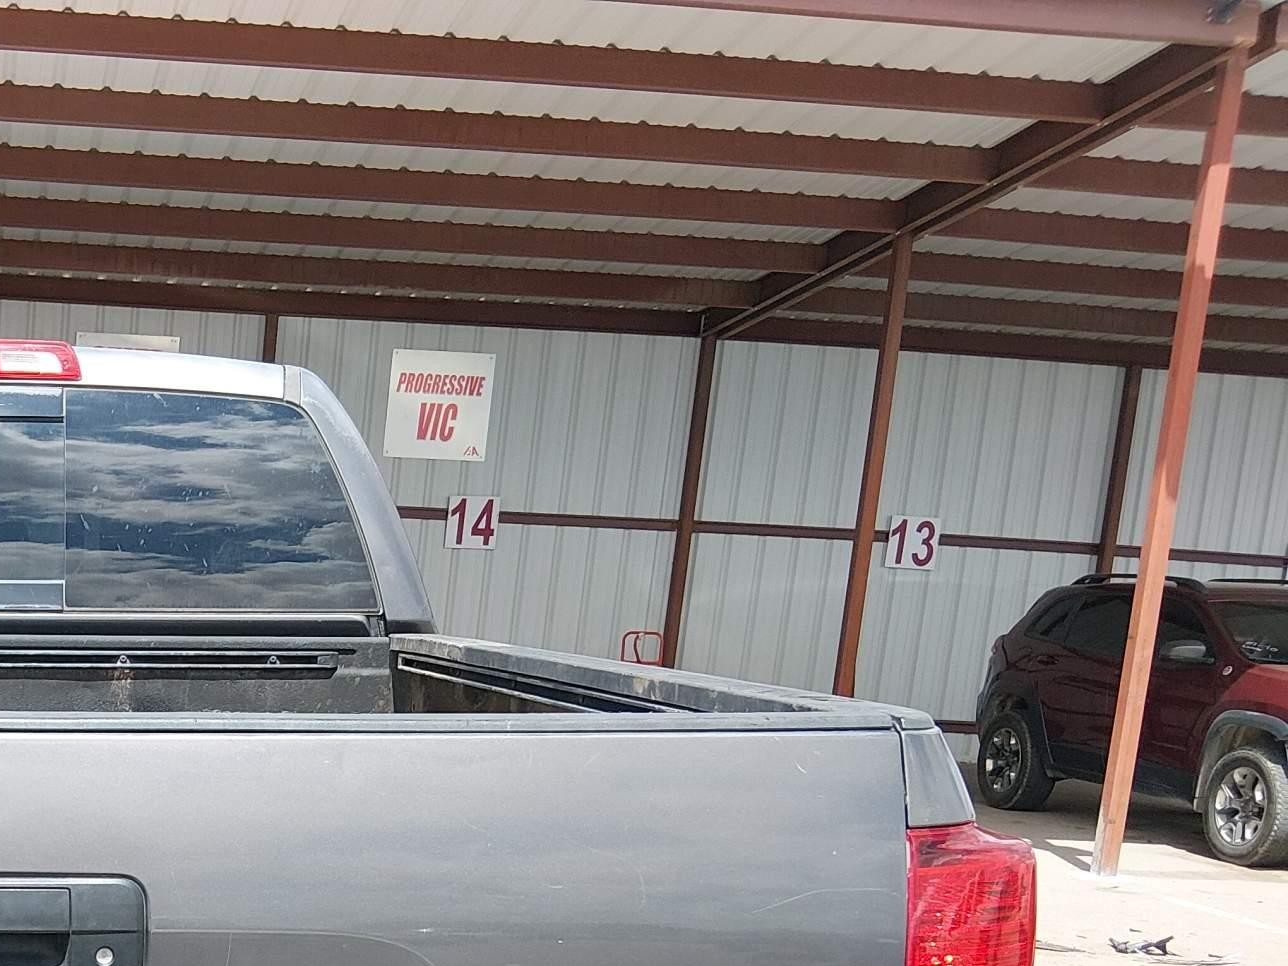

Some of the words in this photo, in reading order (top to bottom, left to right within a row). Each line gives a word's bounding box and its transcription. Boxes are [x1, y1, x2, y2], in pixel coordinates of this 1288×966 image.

[396, 372, 486, 397] PROGRESSIVE
[416, 402, 458, 442] VIC
[450, 498, 495, 546] 14
[890, 518, 936, 567] 13
